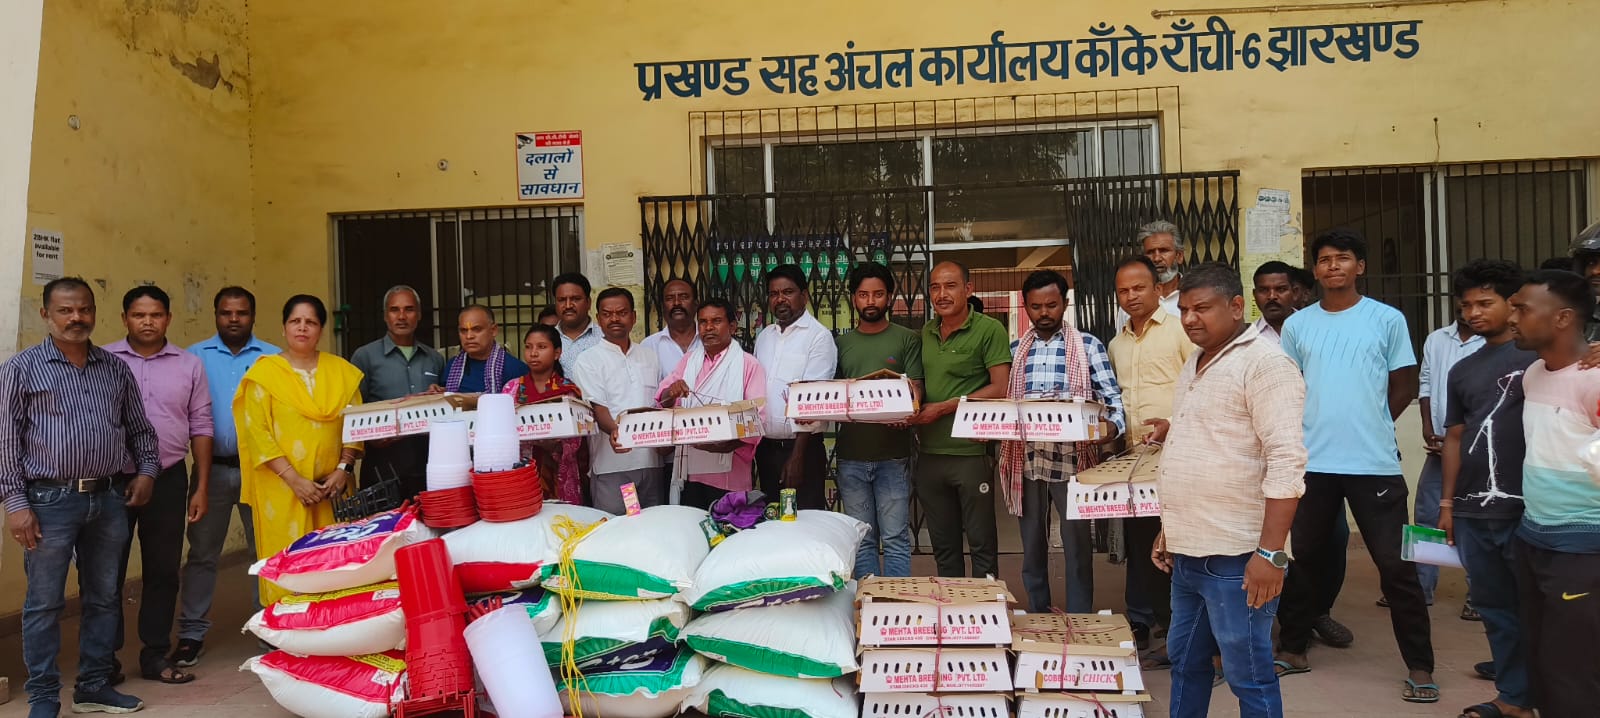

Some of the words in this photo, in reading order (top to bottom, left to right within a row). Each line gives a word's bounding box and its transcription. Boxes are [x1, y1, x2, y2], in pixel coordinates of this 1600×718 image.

[634, 58, 751, 101] प्रखण्ड
[760, 55, 819, 96] सह
[825, 41, 914, 91] अंचल
[919, 31, 1072, 86] कार्यालय
[1075, 25, 1158, 77] काँके
[1266, 20, 1423, 72] झारखण्ड
[525, 148, 574, 166] दलालों
[544, 165, 559, 180] से
[520, 183, 581, 195] सावधान
[34, 243, 59, 251] available
[888, 627, 912, 636] MEHTA
[952, 626, 967, 634] PVT.
[968, 625, 982, 634] LTD.
[894, 675, 917, 683] MEHTA
[957, 674, 972, 682] PVT.
[973, 674, 988, 682] LTD.
